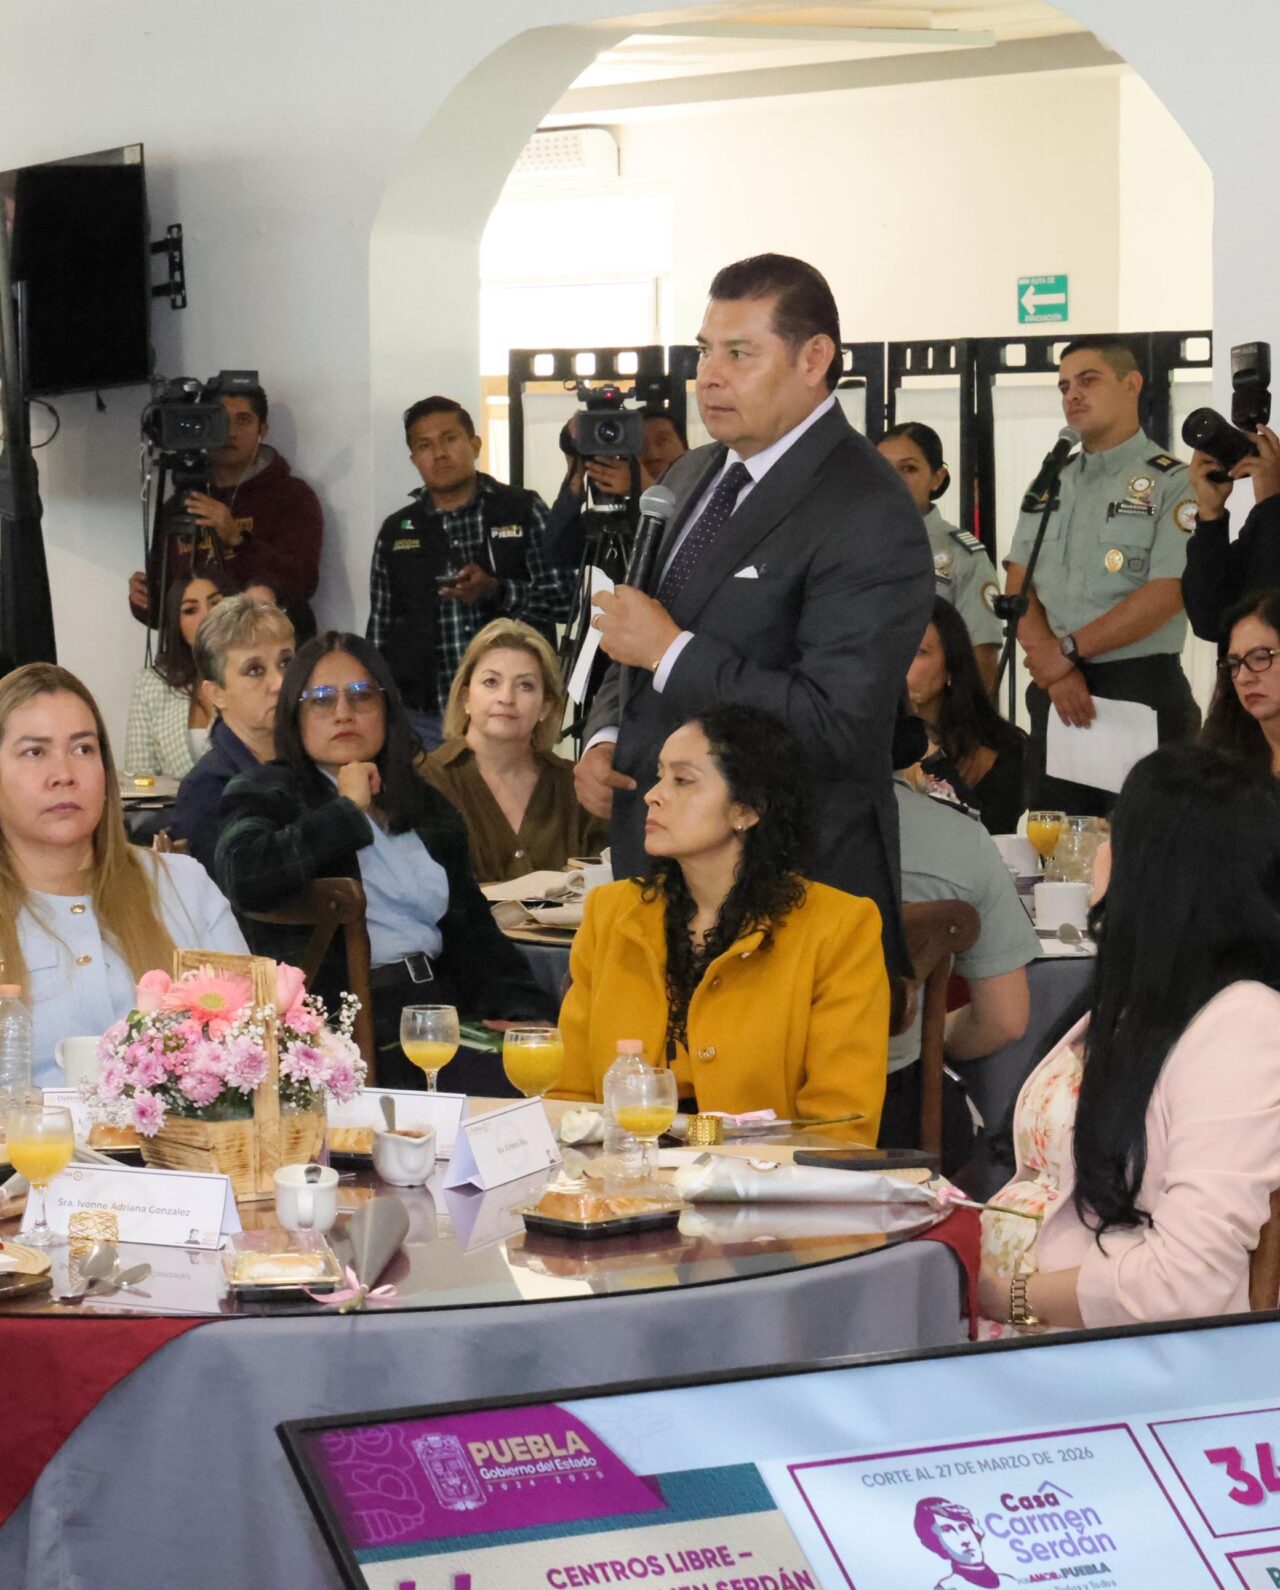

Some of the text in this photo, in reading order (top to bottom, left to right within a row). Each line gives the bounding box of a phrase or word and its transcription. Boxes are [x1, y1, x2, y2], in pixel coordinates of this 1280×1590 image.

[58, 1197, 74, 1208] Sra.
[77, 1199, 109, 1211] Ivonne
[111, 1201, 146, 1213] Adriana
[467, 1430, 591, 1467] PUEBLA
[480, 1456, 597, 1480] Gobierno del Estado
[861, 1447, 1094, 1488] CORTE AL 27 DE MARZO DE 2026
[1000, 1491, 1061, 1512] Casa
[984, 1506, 1103, 1539] Carmen
[1008, 1525, 1117, 1563] Serdán
[545, 1554, 666, 1590] CENTROS
[665, 1546, 736, 1574] LIBRE
[1060, 1562, 1112, 1579] PUEBLA
